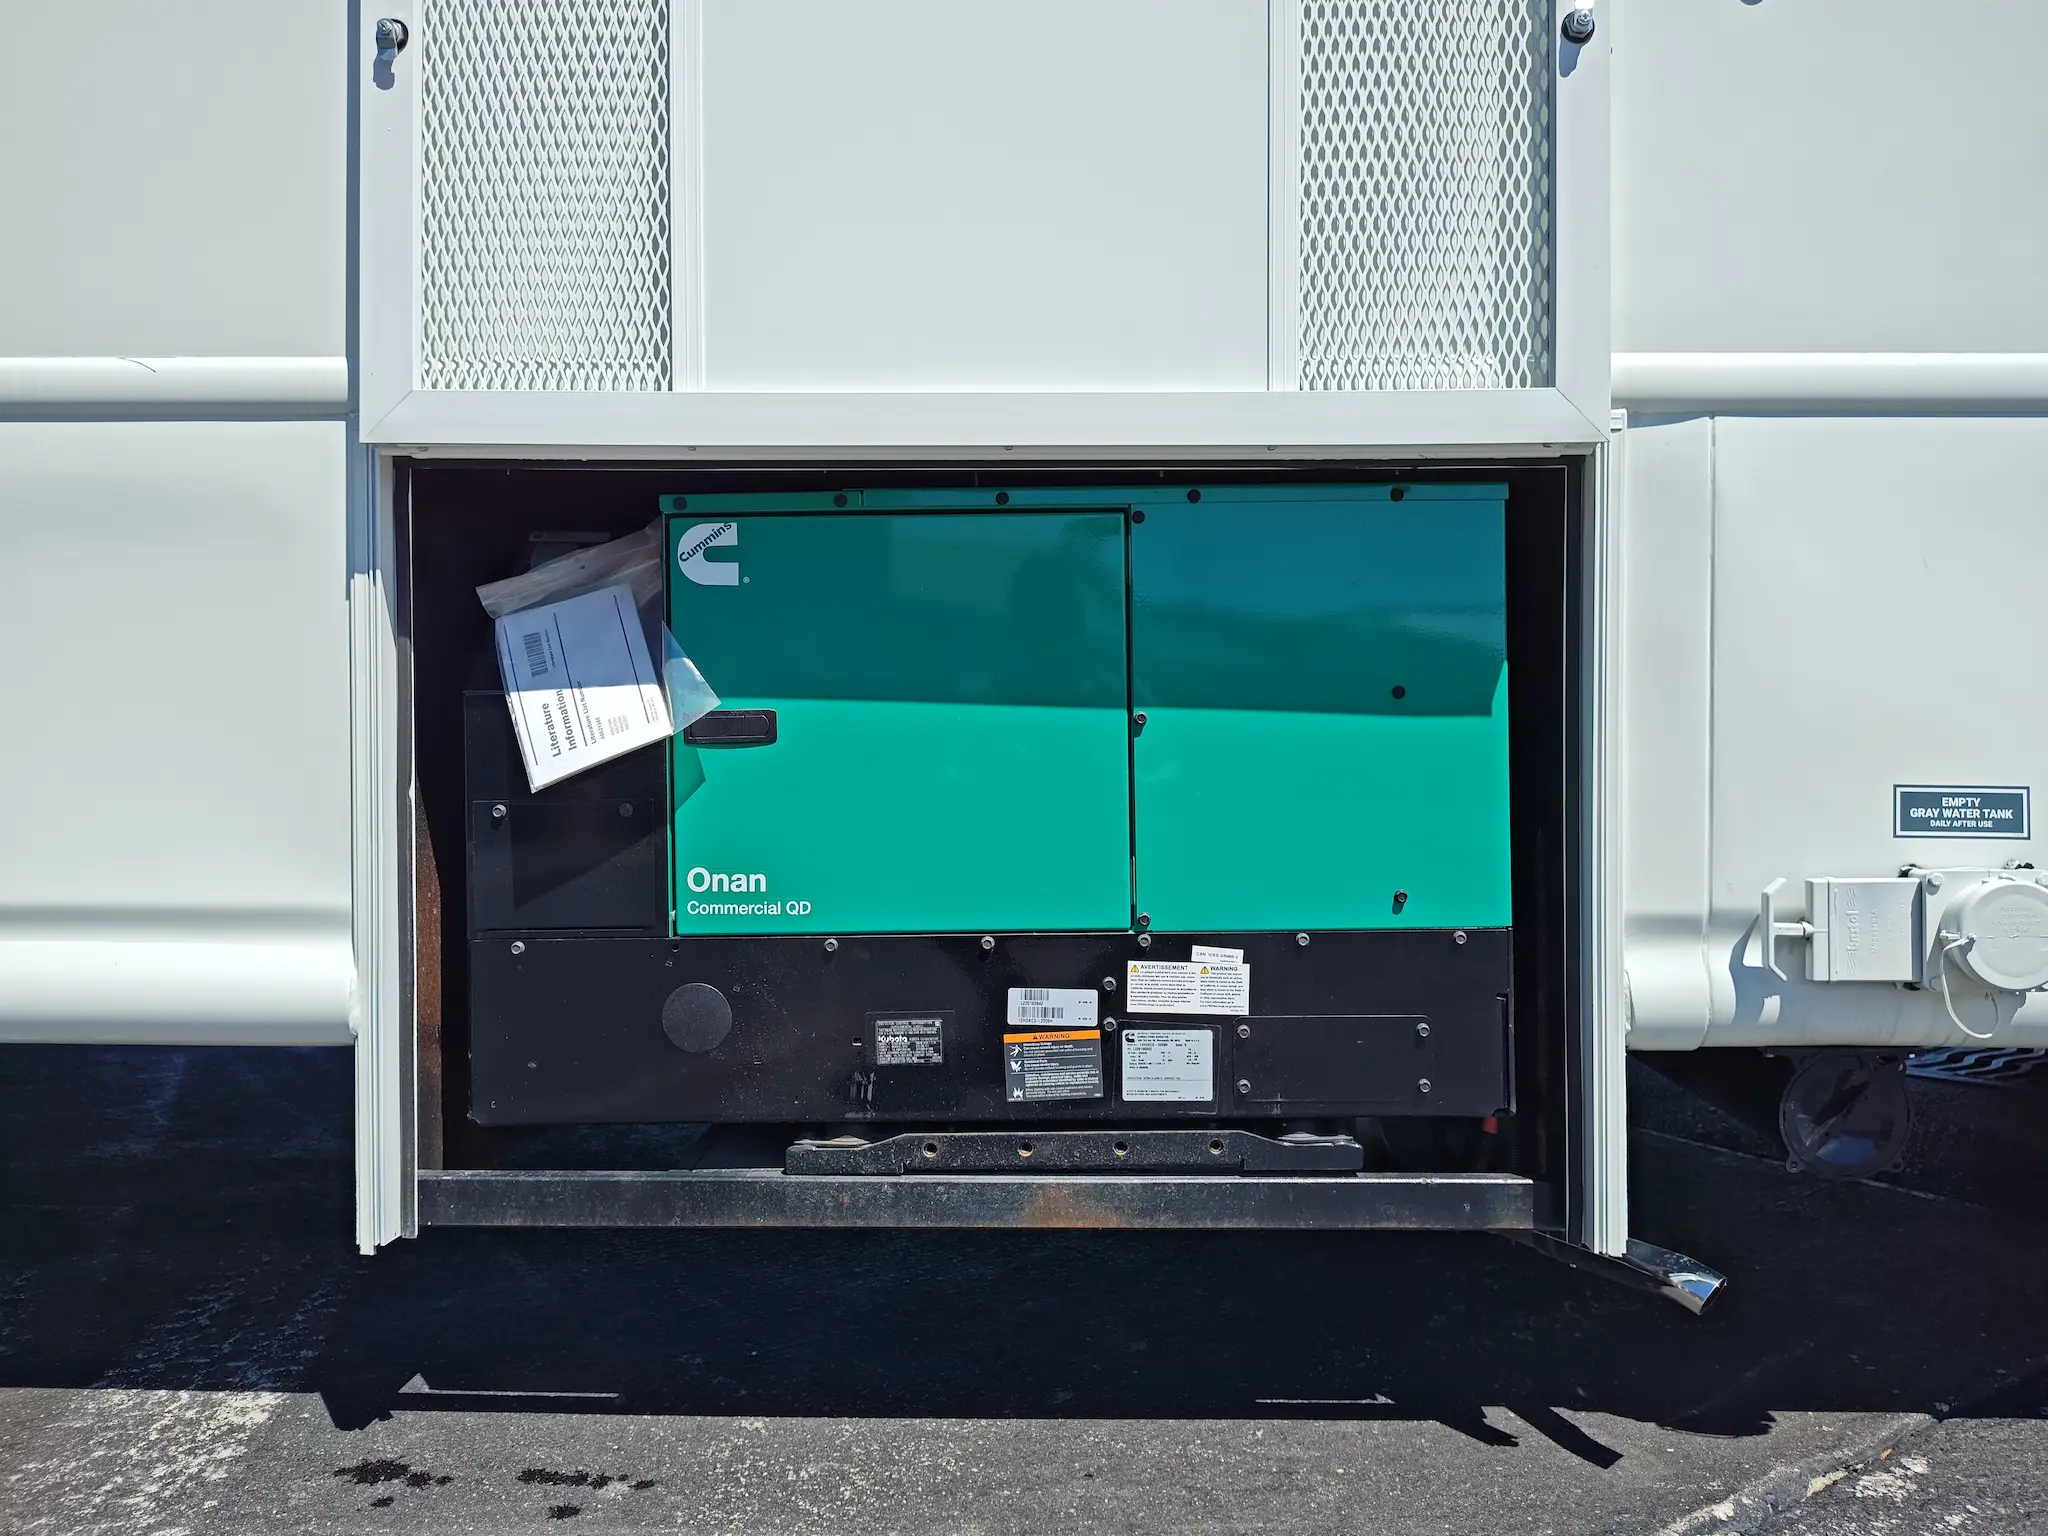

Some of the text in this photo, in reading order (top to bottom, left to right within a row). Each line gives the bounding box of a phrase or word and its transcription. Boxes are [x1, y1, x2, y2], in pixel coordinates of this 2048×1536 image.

[679, 522, 732, 562] Cummins
[542, 703, 562, 758] Literature
[556, 689, 577, 751] Information
[585, 714, 597, 745] Literature
[1941, 797, 1981, 807] EMPTY
[1909, 808, 2014, 819] GRAY WATER TANK
[1978, 820, 1993, 828] USE
[687, 867, 767, 893] Onan
[687, 900, 812, 916] Commercial QD
[878, 1034, 908, 1042] Kubota
